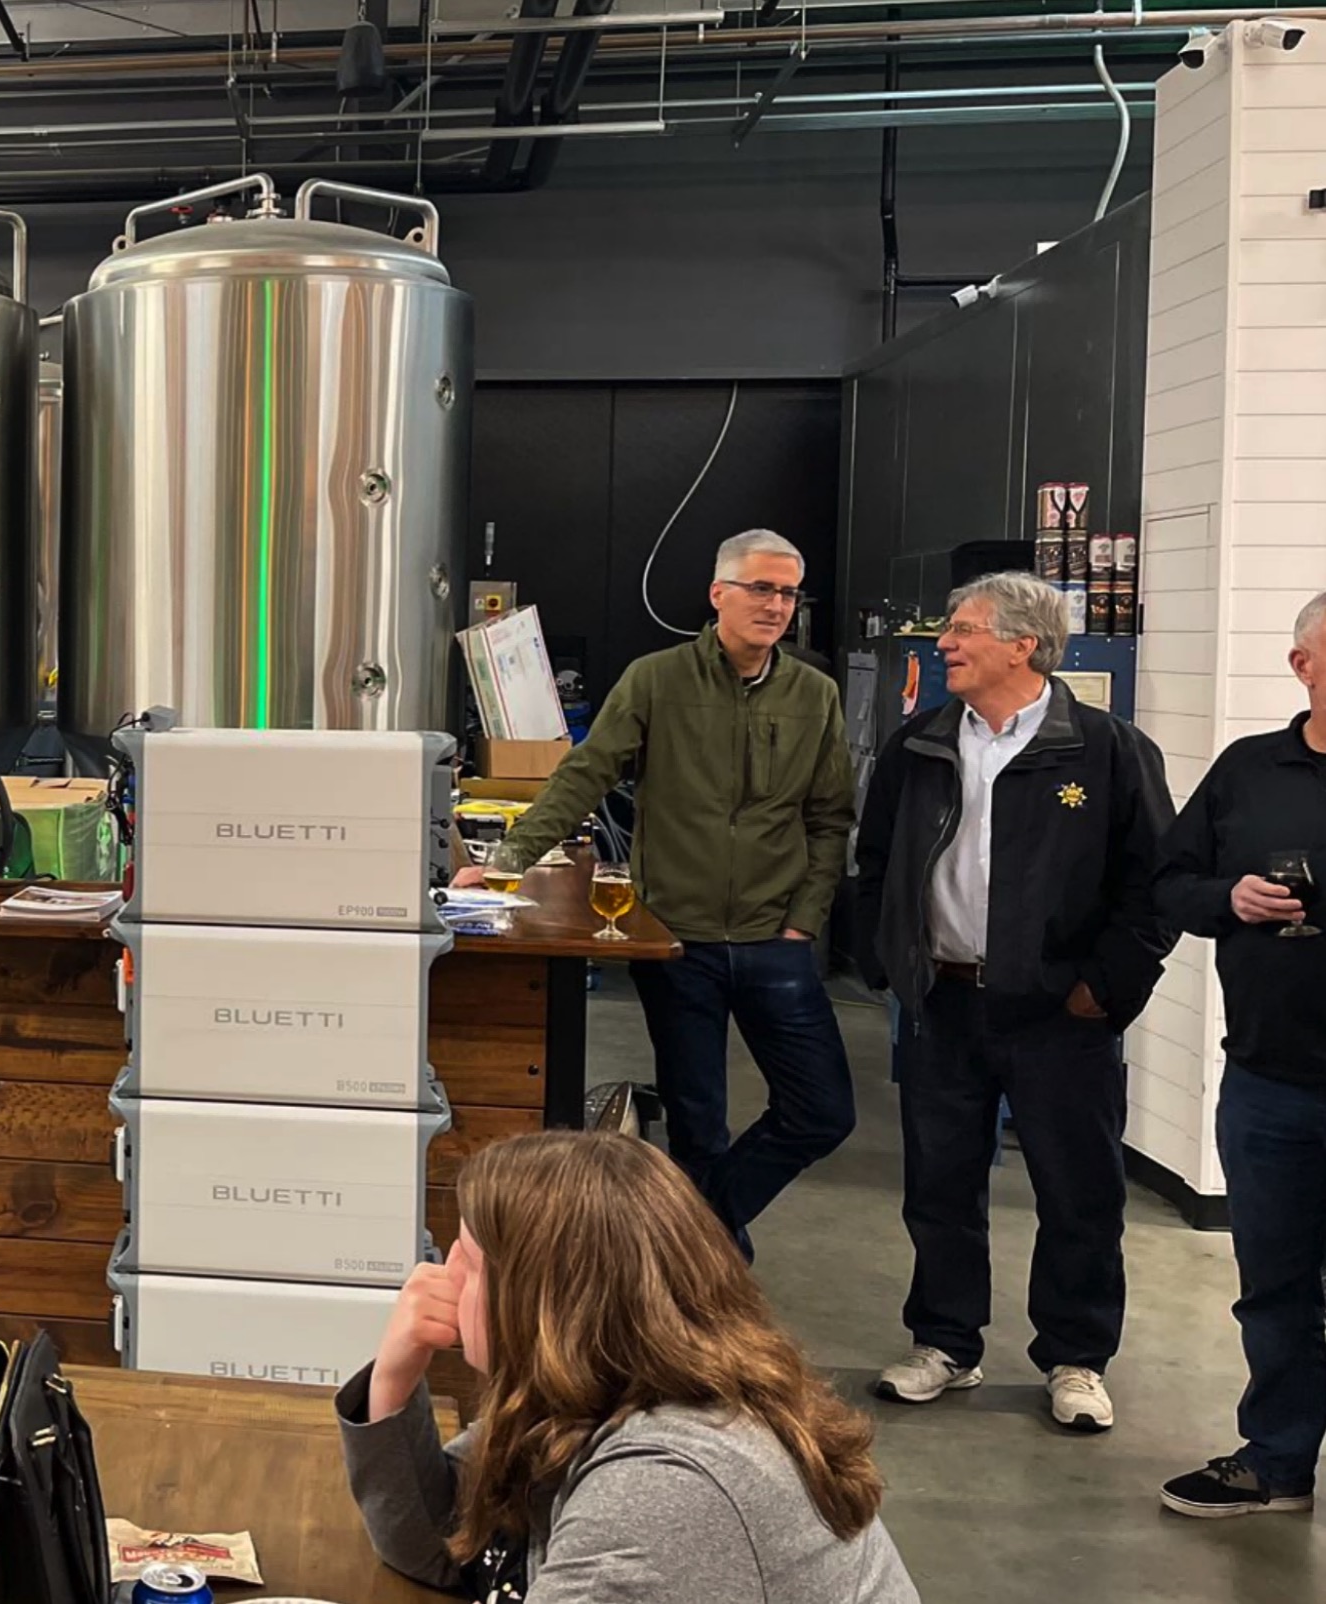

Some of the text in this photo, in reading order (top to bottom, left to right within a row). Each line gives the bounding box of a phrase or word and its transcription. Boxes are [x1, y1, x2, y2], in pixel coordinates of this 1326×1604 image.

[216, 823, 346, 841] BLUETTI
[338, 904, 374, 917] EP900
[214, 1008, 343, 1028] BLUETTI
[336, 1079, 368, 1093] B500
[212, 1185, 342, 1207] BLUETTI
[334, 1257, 365, 1272] B500
[210, 1361, 339, 1383] BLUETTI
